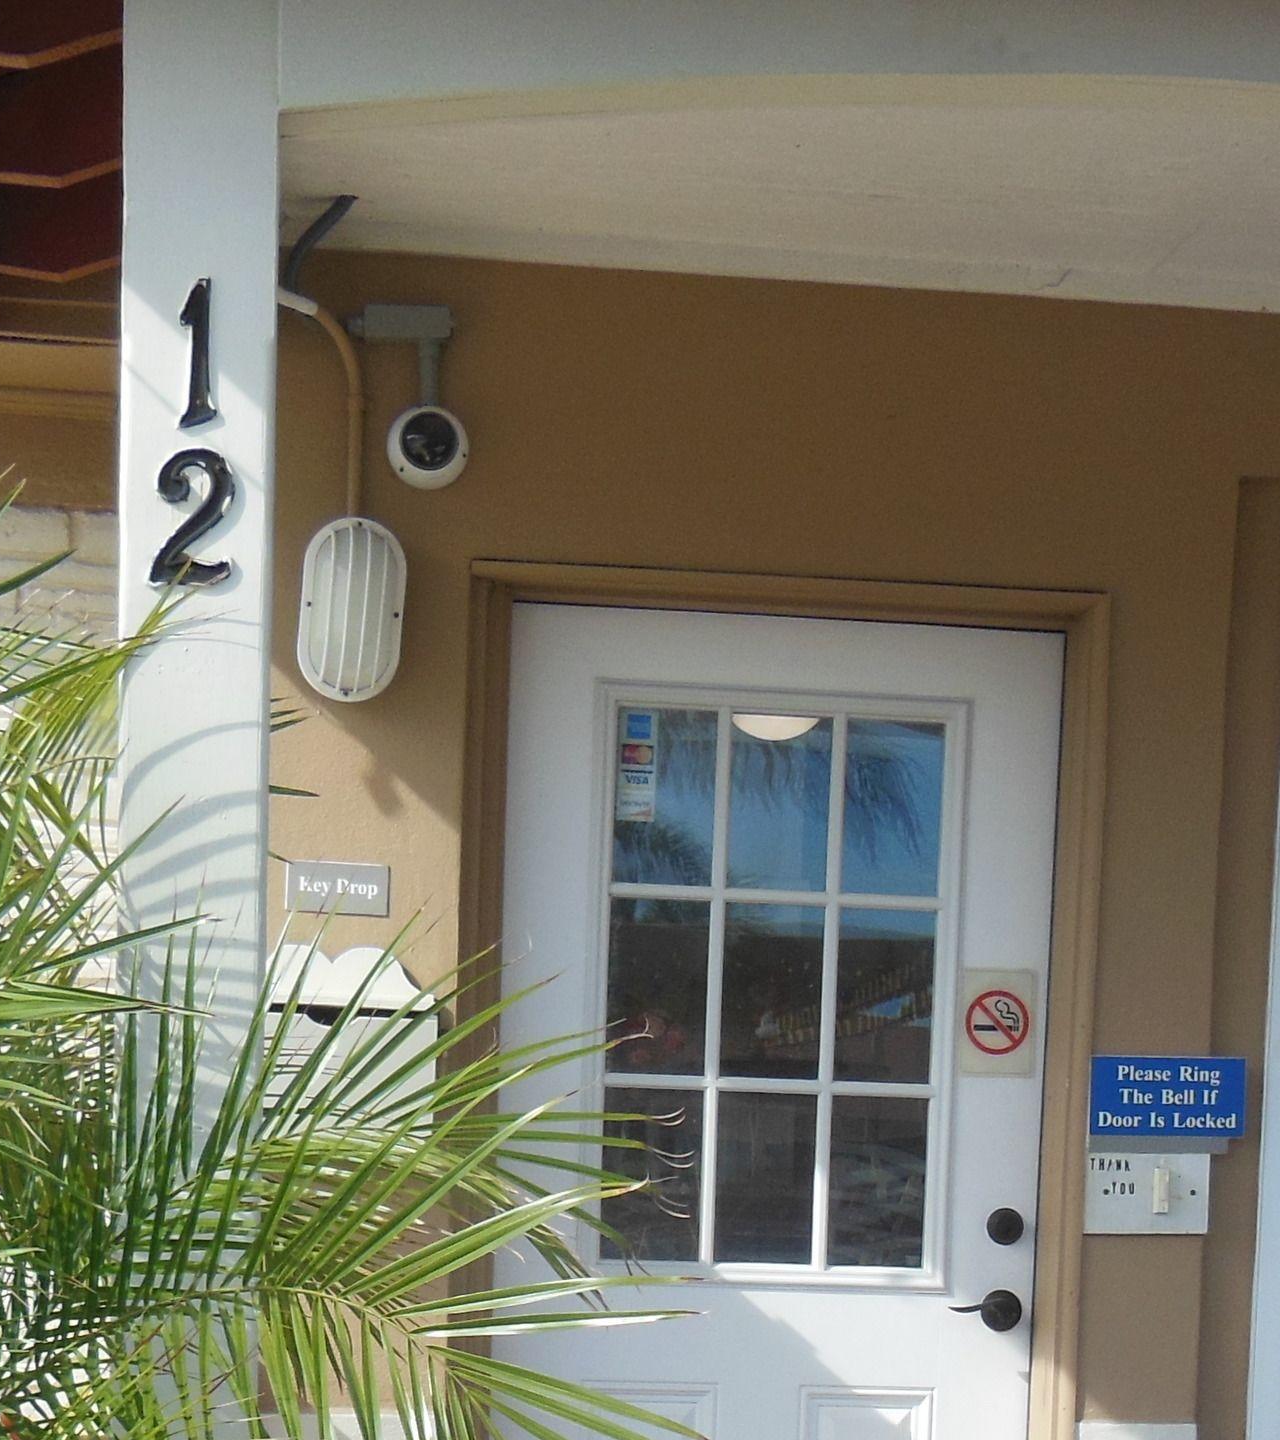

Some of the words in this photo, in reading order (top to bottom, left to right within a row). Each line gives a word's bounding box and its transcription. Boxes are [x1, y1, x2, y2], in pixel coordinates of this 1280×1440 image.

[624, 774, 649, 785] VISA
[298, 876, 331, 897] Key
[336, 878, 378, 900] Drop
[1117, 1065, 1171, 1082] Please
[1179, 1066, 1221, 1087] Ring
[1119, 1088, 1153, 1105] The
[1161, 1089, 1195, 1106] Bell
[1202, 1089, 1219, 1106] If
[1097, 1111, 1142, 1128] Door
[1150, 1112, 1165, 1128] Is
[1173, 1112, 1237, 1129] Locked
